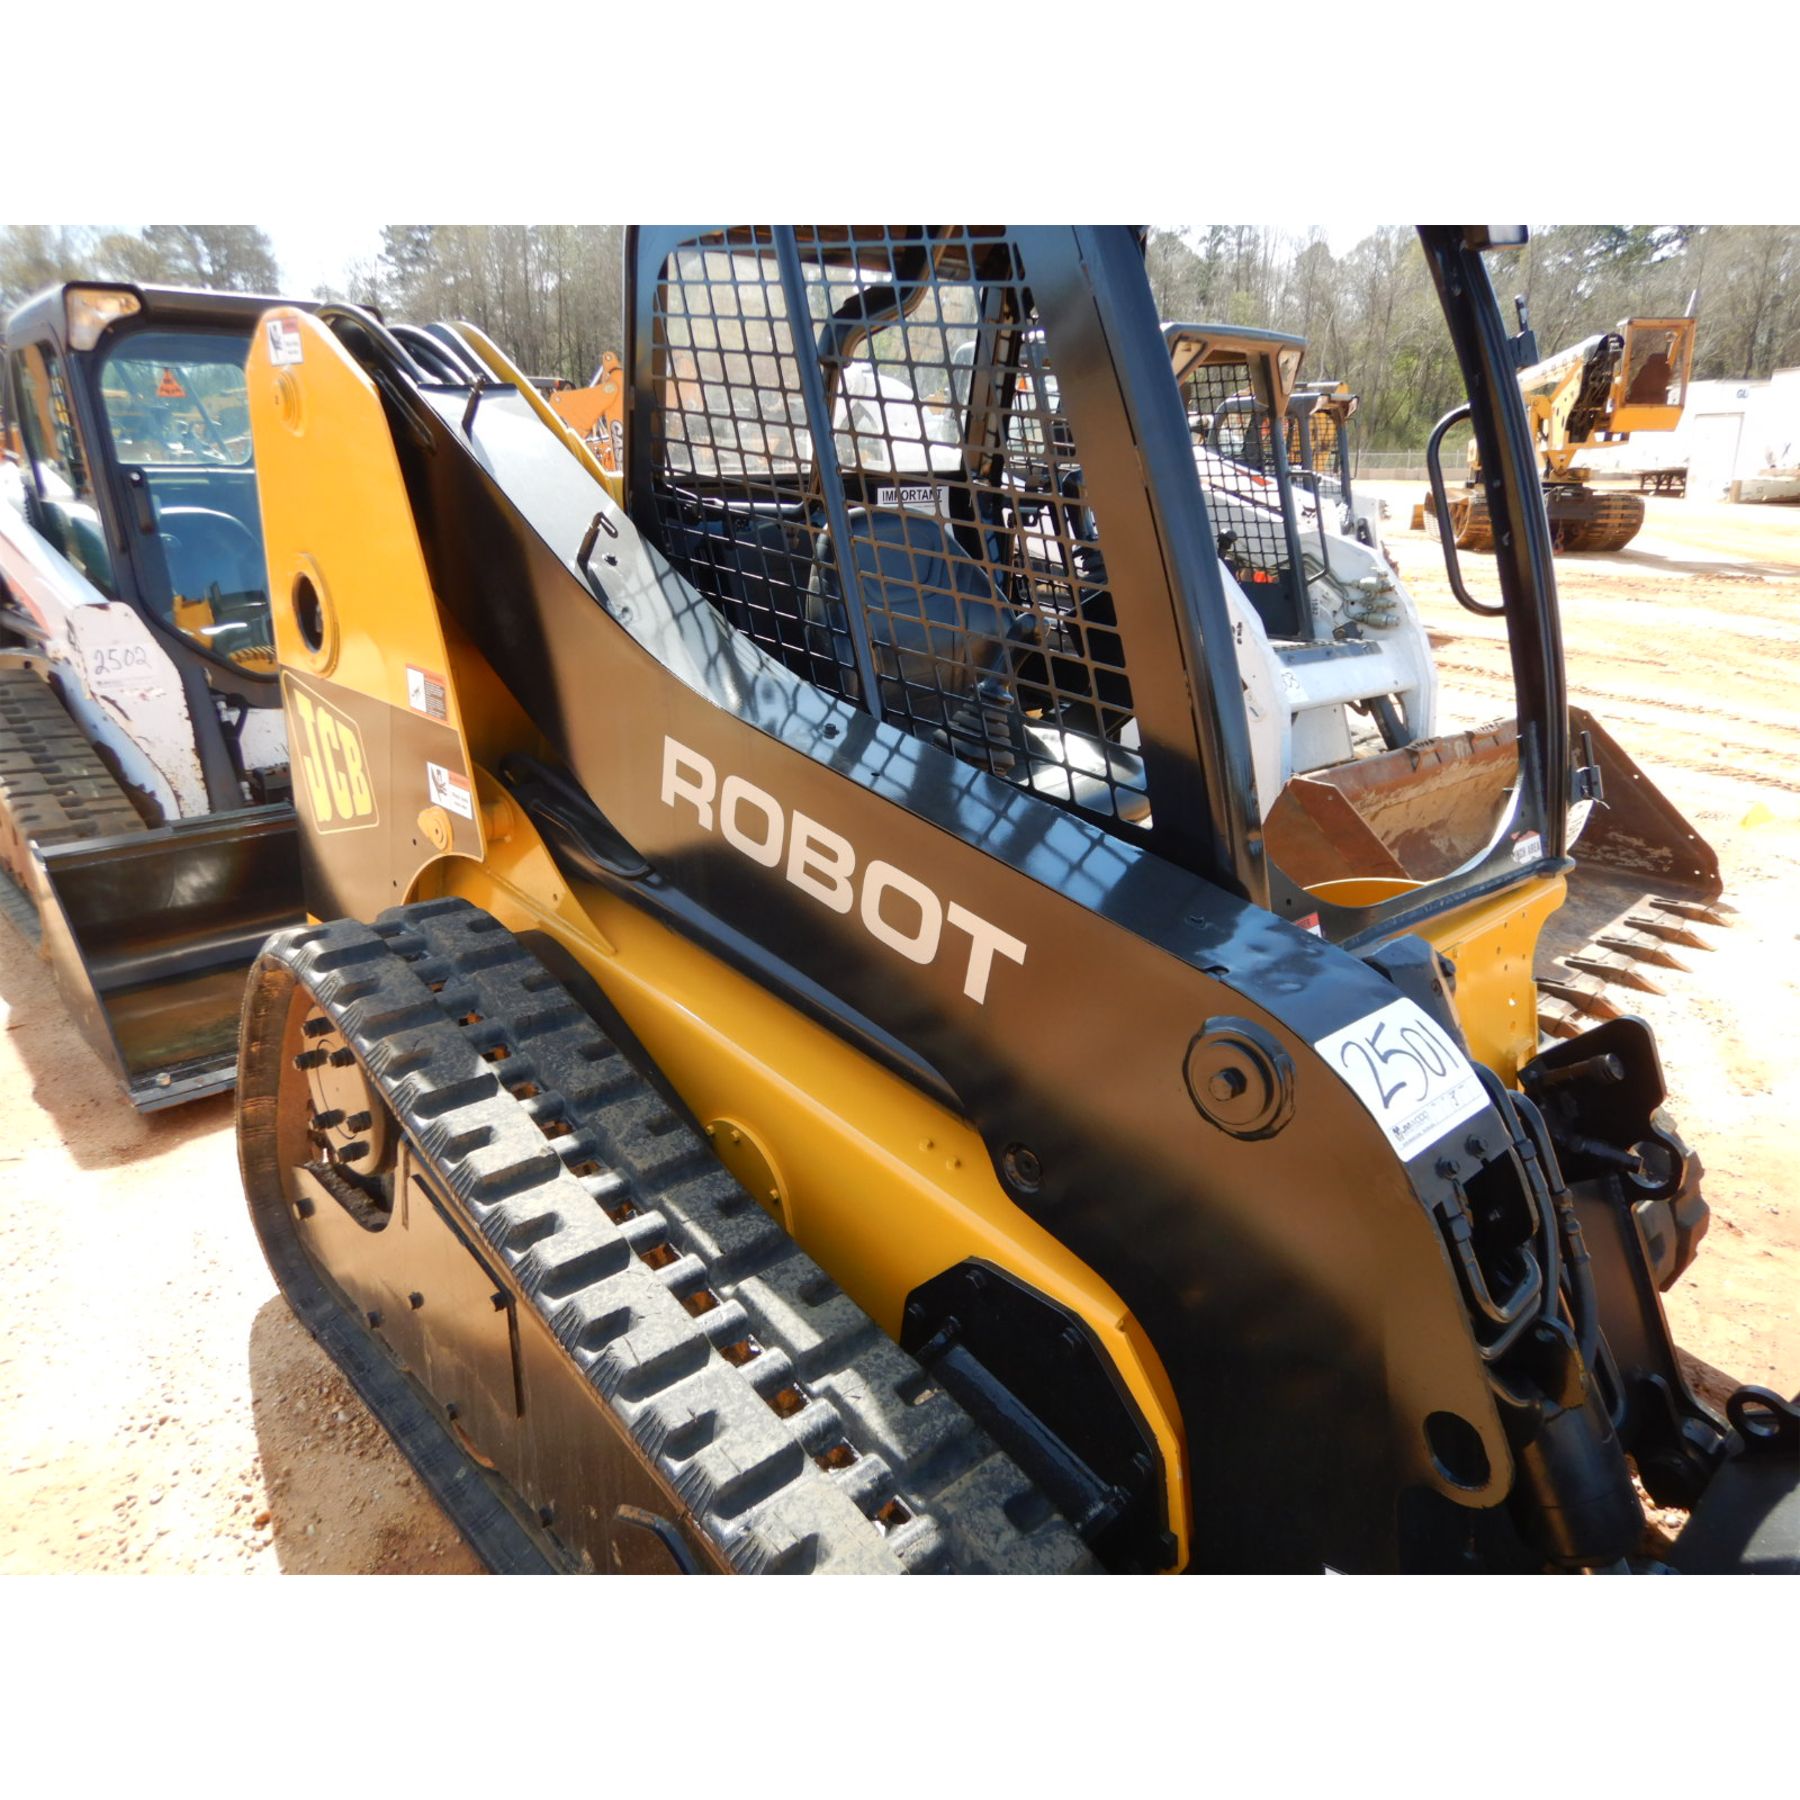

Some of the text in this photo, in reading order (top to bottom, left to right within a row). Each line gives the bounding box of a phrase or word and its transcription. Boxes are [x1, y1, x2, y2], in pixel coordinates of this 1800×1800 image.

[94, 646, 153, 676] 2502
[293, 688, 373, 822] JCB
[661, 735, 1027, 1005] ROBOT
[1340, 1019, 1460, 1110] 2501
